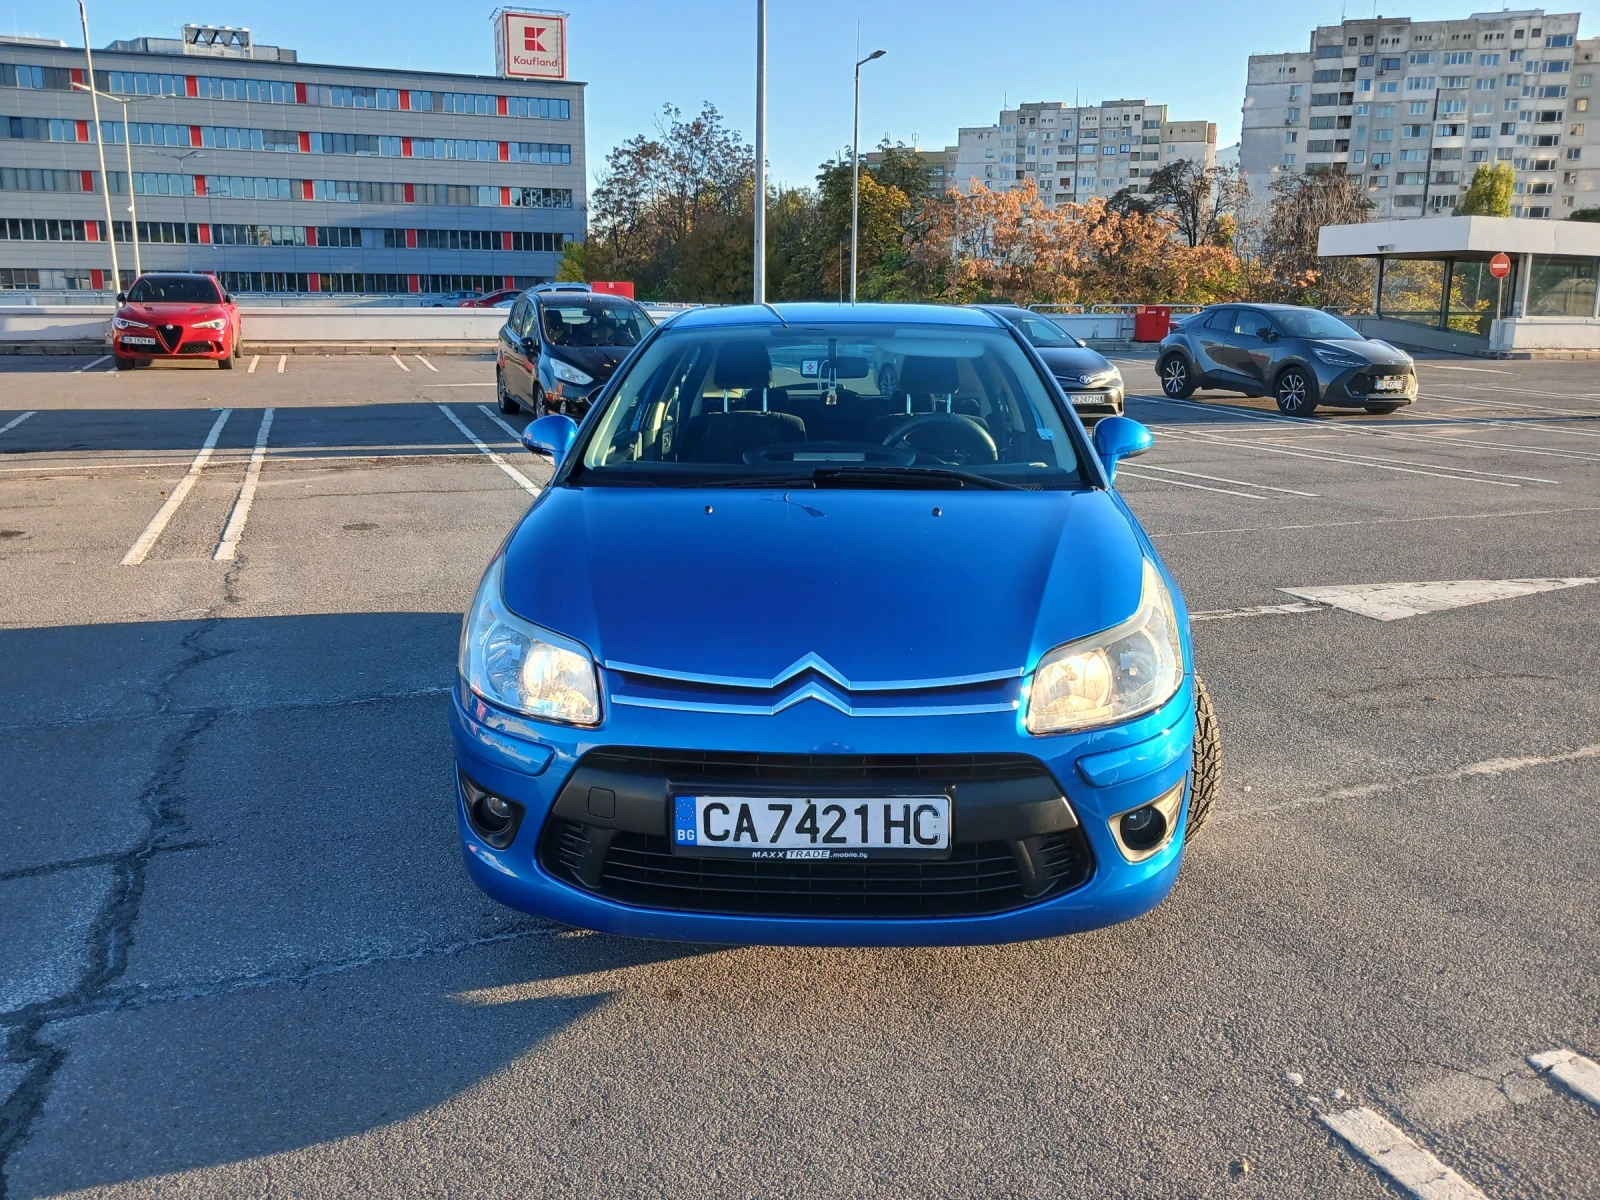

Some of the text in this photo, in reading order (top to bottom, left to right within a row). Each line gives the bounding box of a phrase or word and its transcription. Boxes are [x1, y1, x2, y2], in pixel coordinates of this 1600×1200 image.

[513, 55, 558, 67] Kaufland
[677, 830, 695, 841] BG
[751, 851, 785, 859] MAXX
